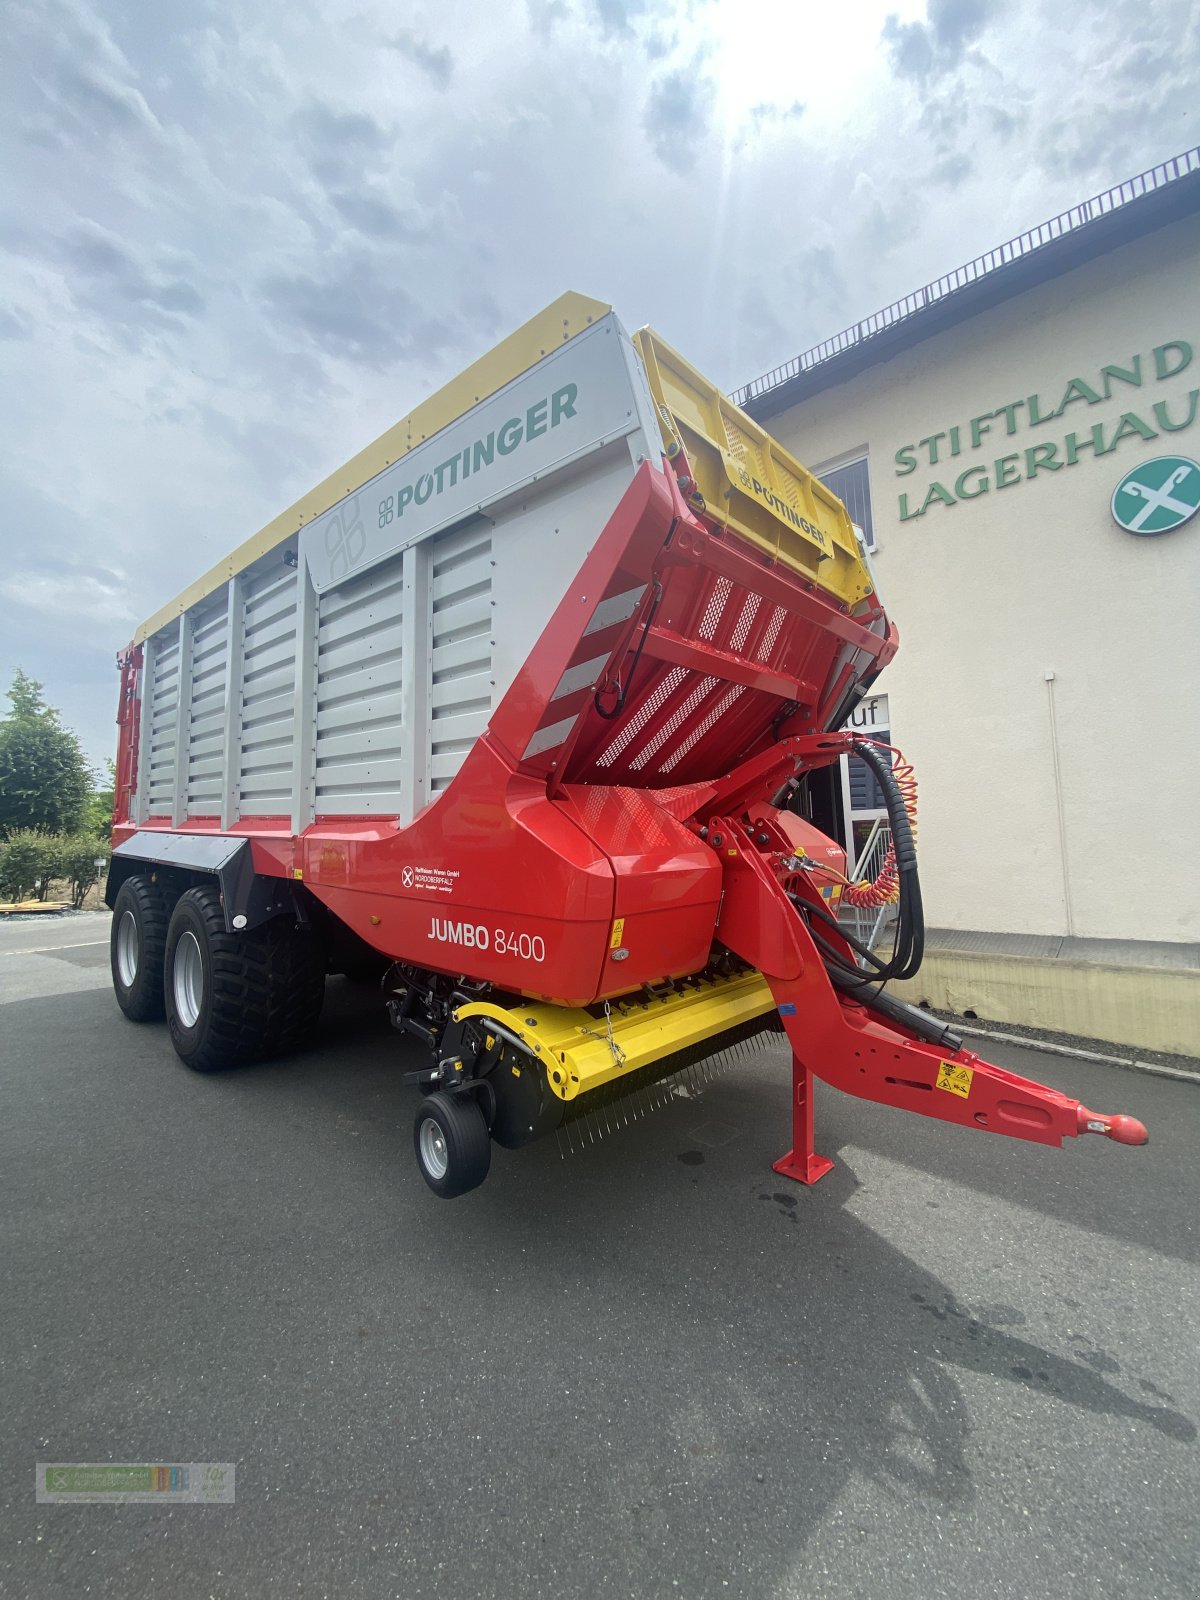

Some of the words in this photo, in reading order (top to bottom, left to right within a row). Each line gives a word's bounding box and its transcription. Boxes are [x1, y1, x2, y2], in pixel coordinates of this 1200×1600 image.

[397, 382, 578, 518] PÖTTINGER
[894, 340, 1193, 476] STIFTLAND
[841, 698, 878, 728] uf
[427, 917, 489, 950] JUMBO
[494, 929, 546, 962] 8400
